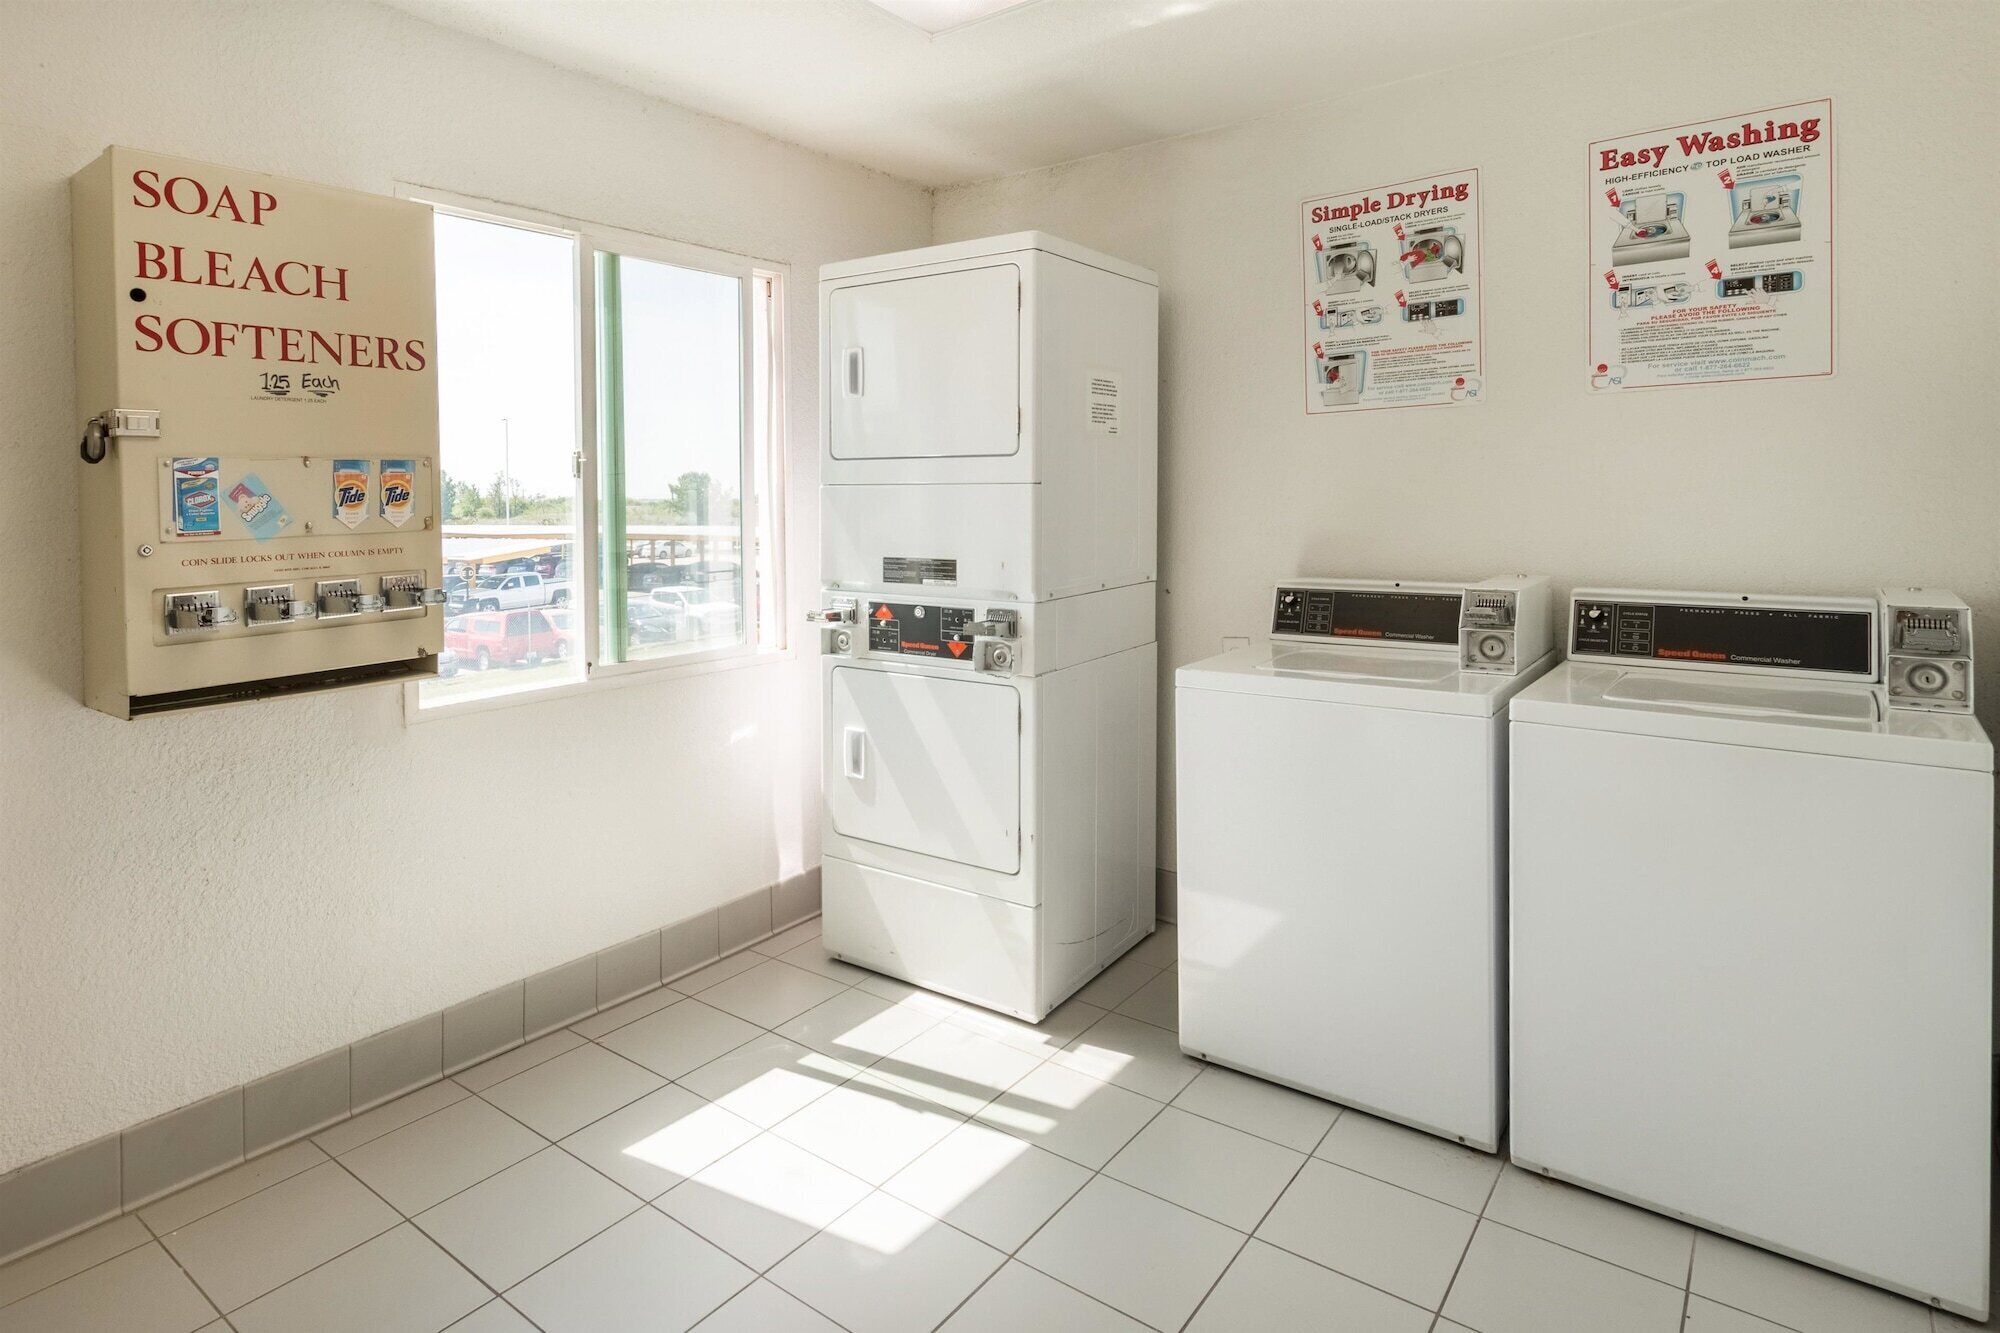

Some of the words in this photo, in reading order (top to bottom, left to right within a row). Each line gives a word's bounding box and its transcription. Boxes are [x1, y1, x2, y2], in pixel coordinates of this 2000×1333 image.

[1600, 144, 1669, 171] Easy
[1675, 118, 1821, 157] Washing
[1605, 165, 1689, 185] HIGH-EFFICIENCY
[1706, 159, 1727, 168] TOP
[1730, 153, 1760, 164] LOAD
[1763, 144, 1811, 159] WASHER
[132, 169, 278, 226] SOAP
[1312, 196, 1381, 223] Simple
[1386, 183, 1469, 210] Drying
[1329, 213, 1412, 234] SINGLE-LOAD/STACK
[1413, 206, 1449, 219] DRYERS
[133, 240, 350, 302] BLEACH
[1709, 303, 1737, 311] SAFETY
[1717, 305, 1761, 314] FOLLOWING
[134, 314, 427, 372] SOFTENERS
[259, 372, 291, 391] 1.25
[301, 373, 341, 391] Each
[338, 486, 366, 507] Tide
[385, 486, 410, 507] Tide
[240, 494, 272, 522] Snuggle
[181, 558, 208, 567] COIN
[210, 556, 238, 565] SLIDE
[240, 554, 272, 563] LOCKS
[274, 553, 295, 561] OUT
[297, 551, 326, 559] WHEN
[328, 549, 366, 558] COLUMN
[368, 548, 375, 556] IS
[377, 546, 405, 555] EMPTY
[901, 640, 920, 650] Speed
[920, 642, 939, 651] Queen
[1384, 631, 1415, 639] Commercial
[1657, 648, 1691, 659] Speed
[1691, 650, 1727, 660] Queen
[1730, 653, 1772, 663] Commercial
[1773, 656, 1801, 665] Washer
